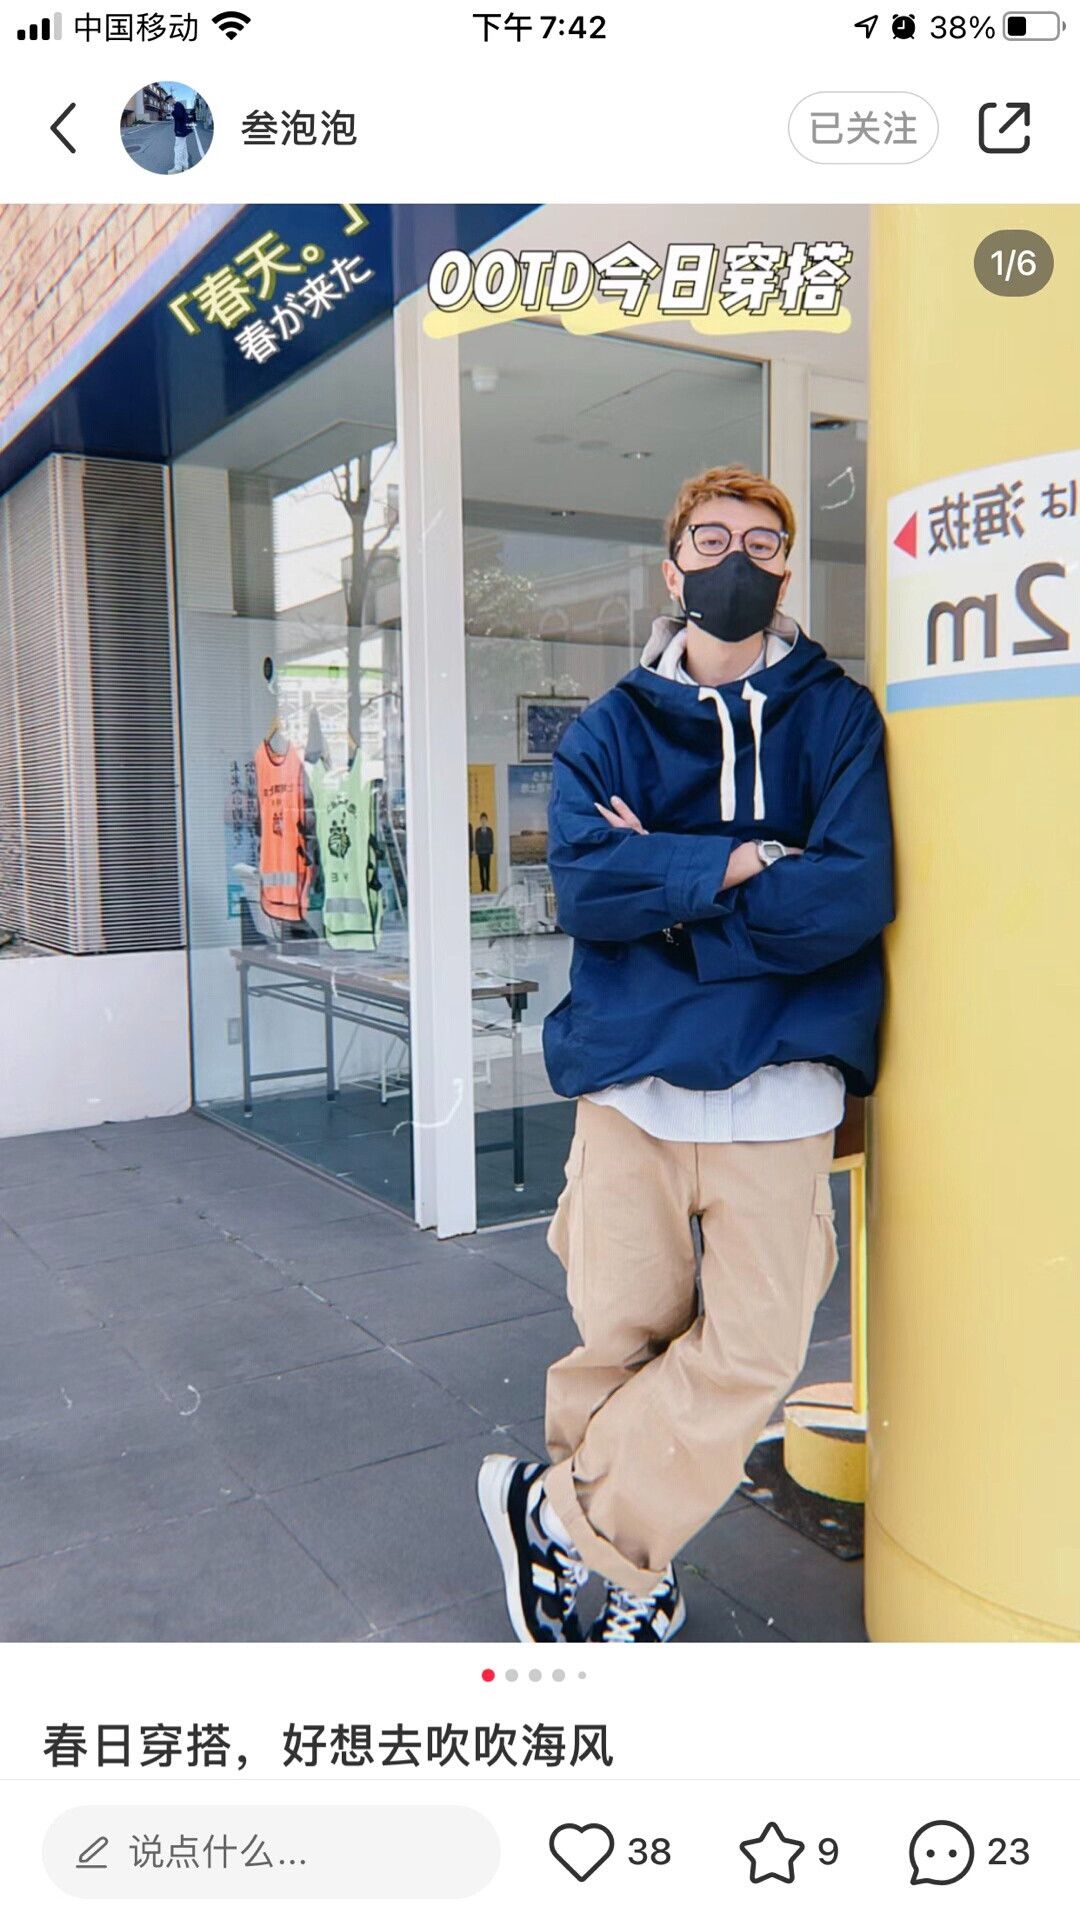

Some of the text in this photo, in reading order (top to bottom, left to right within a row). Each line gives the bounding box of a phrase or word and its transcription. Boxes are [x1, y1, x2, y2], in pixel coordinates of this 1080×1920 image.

[74, 11, 198, 43] 中国移动
[930, 15, 996, 40] 38%
[241, 109, 358, 146] 叁泡泡
[810, 110, 917, 145] 已关注
[990, 249, 1037, 282] 1/6
[628, 1837, 671, 1866] 38
[818, 1837, 839, 1866] 9
[988, 1837, 1030, 1866] 23
